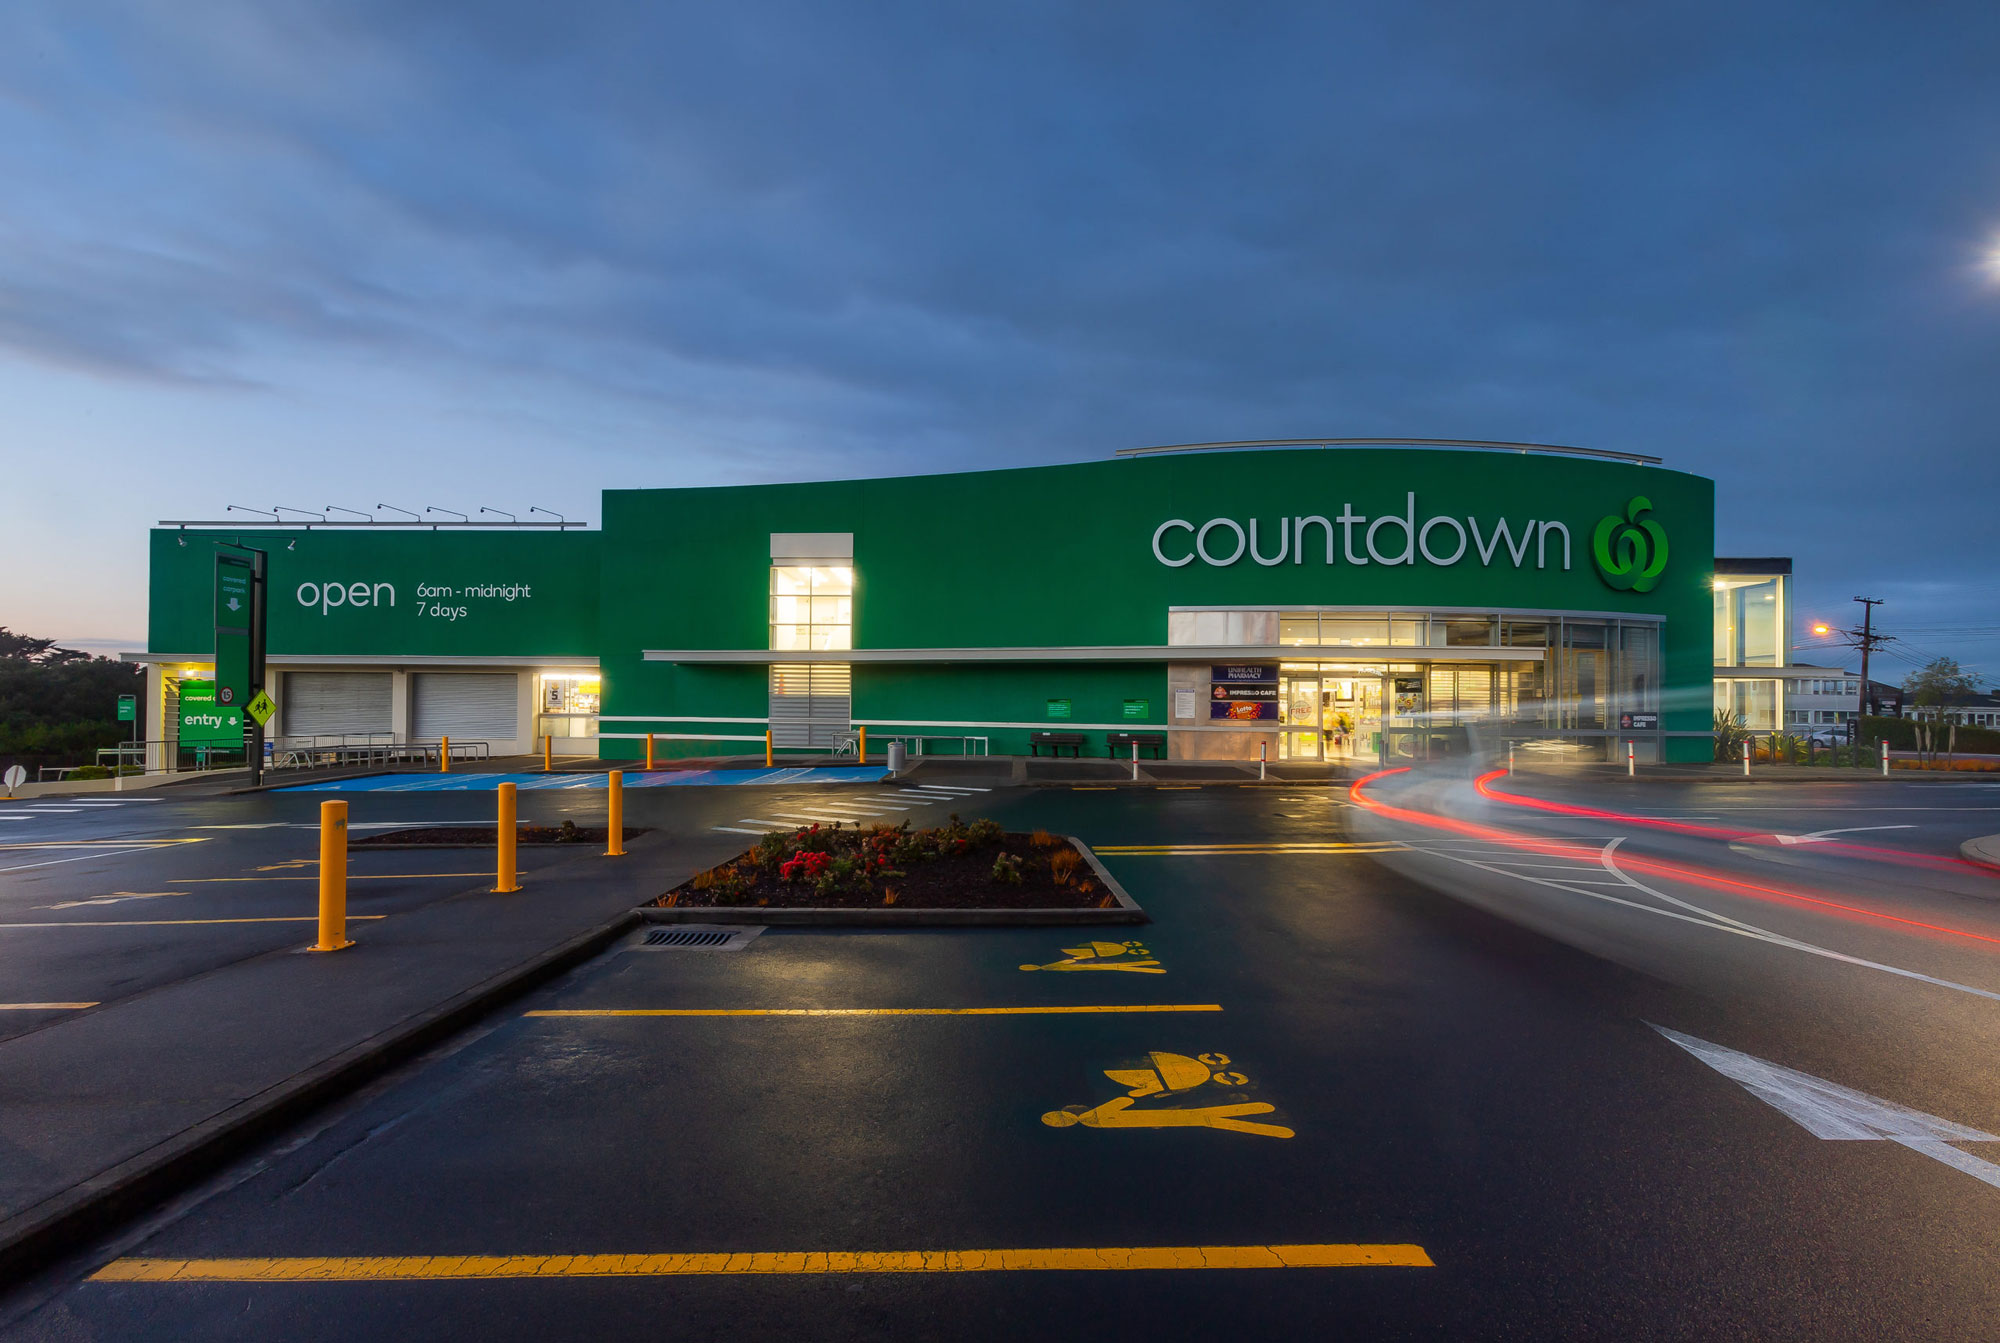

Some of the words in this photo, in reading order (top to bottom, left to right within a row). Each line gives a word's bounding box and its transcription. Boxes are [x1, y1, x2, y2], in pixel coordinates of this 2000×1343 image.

[1152, 491, 1571, 570] countdown
[297, 582, 395, 616] open
[416, 582, 452, 598] 6am
[465, 582, 531, 602] midnight
[416, 602, 426, 617] 7
[430, 602, 467, 622] days
[223, 690, 231, 699] 15
[184, 713, 223, 729] entry
[1290, 707, 1312, 715] FREE
